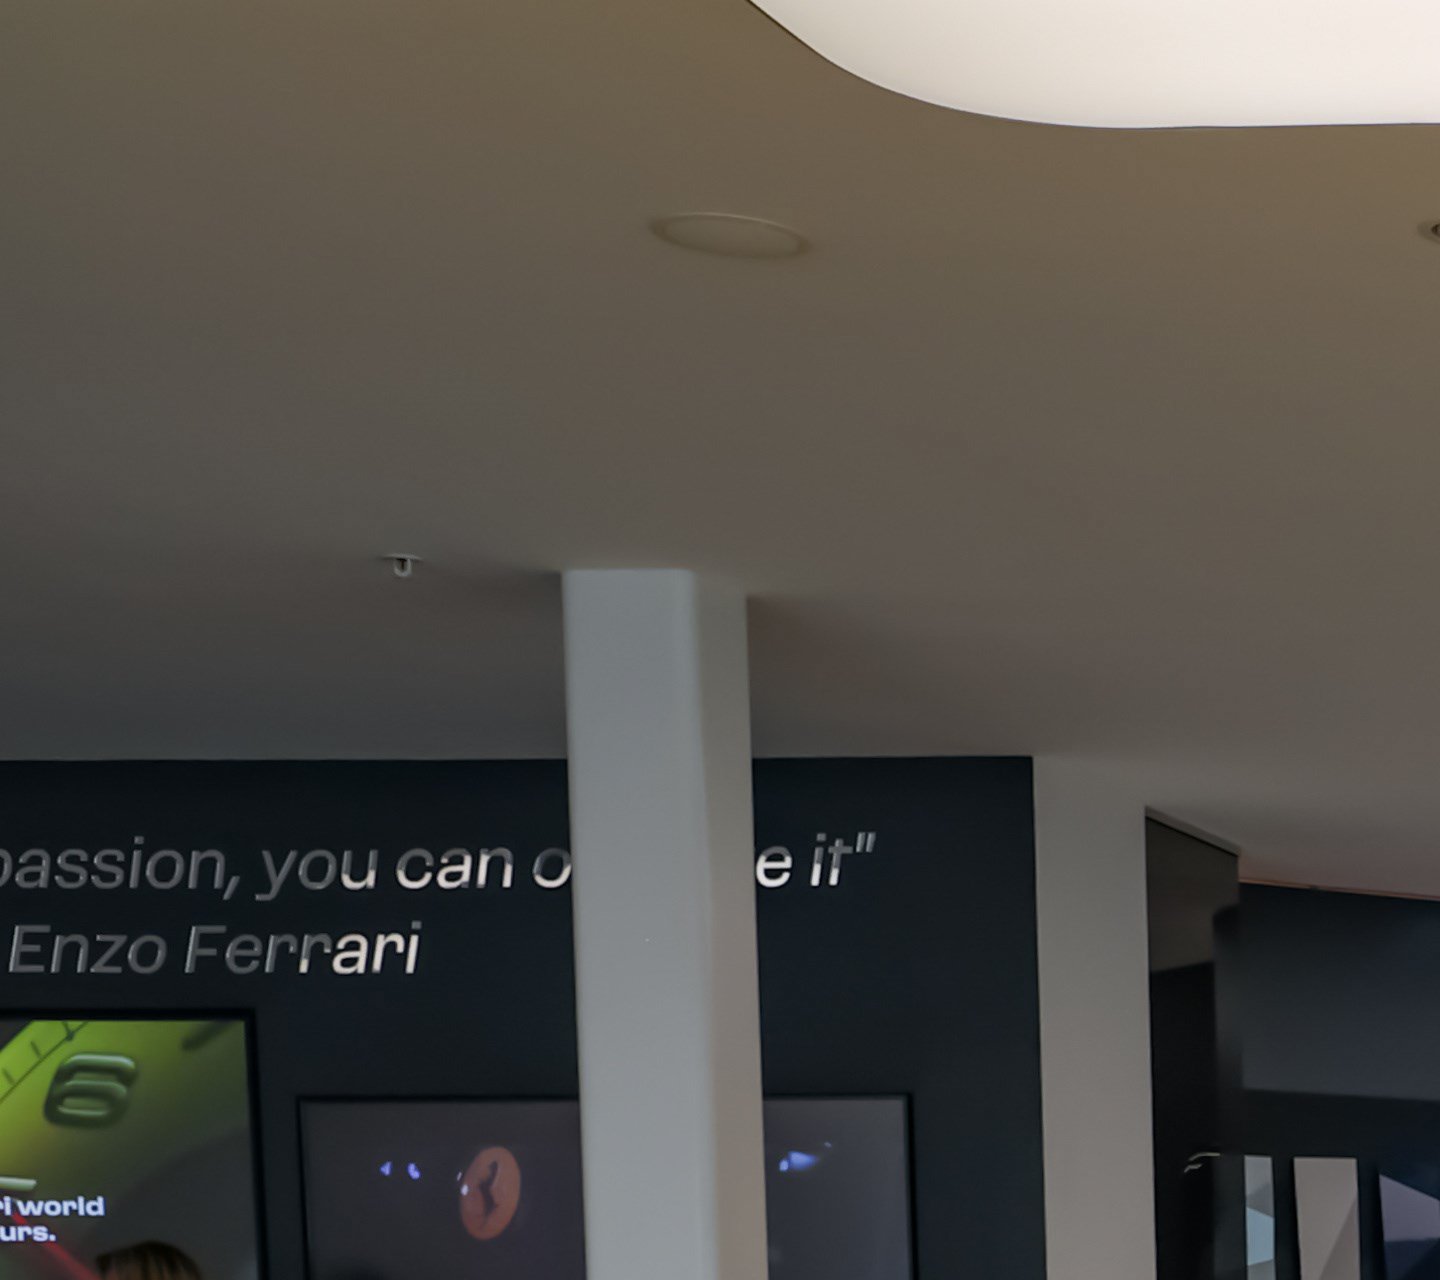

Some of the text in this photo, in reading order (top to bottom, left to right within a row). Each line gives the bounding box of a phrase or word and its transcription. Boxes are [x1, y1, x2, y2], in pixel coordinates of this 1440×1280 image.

[255, 849, 379, 901] you
[396, 848, 514, 889] can
[8, 921, 422, 974] Enzo Ferrari
[16, 1195, 106, 1217] world
